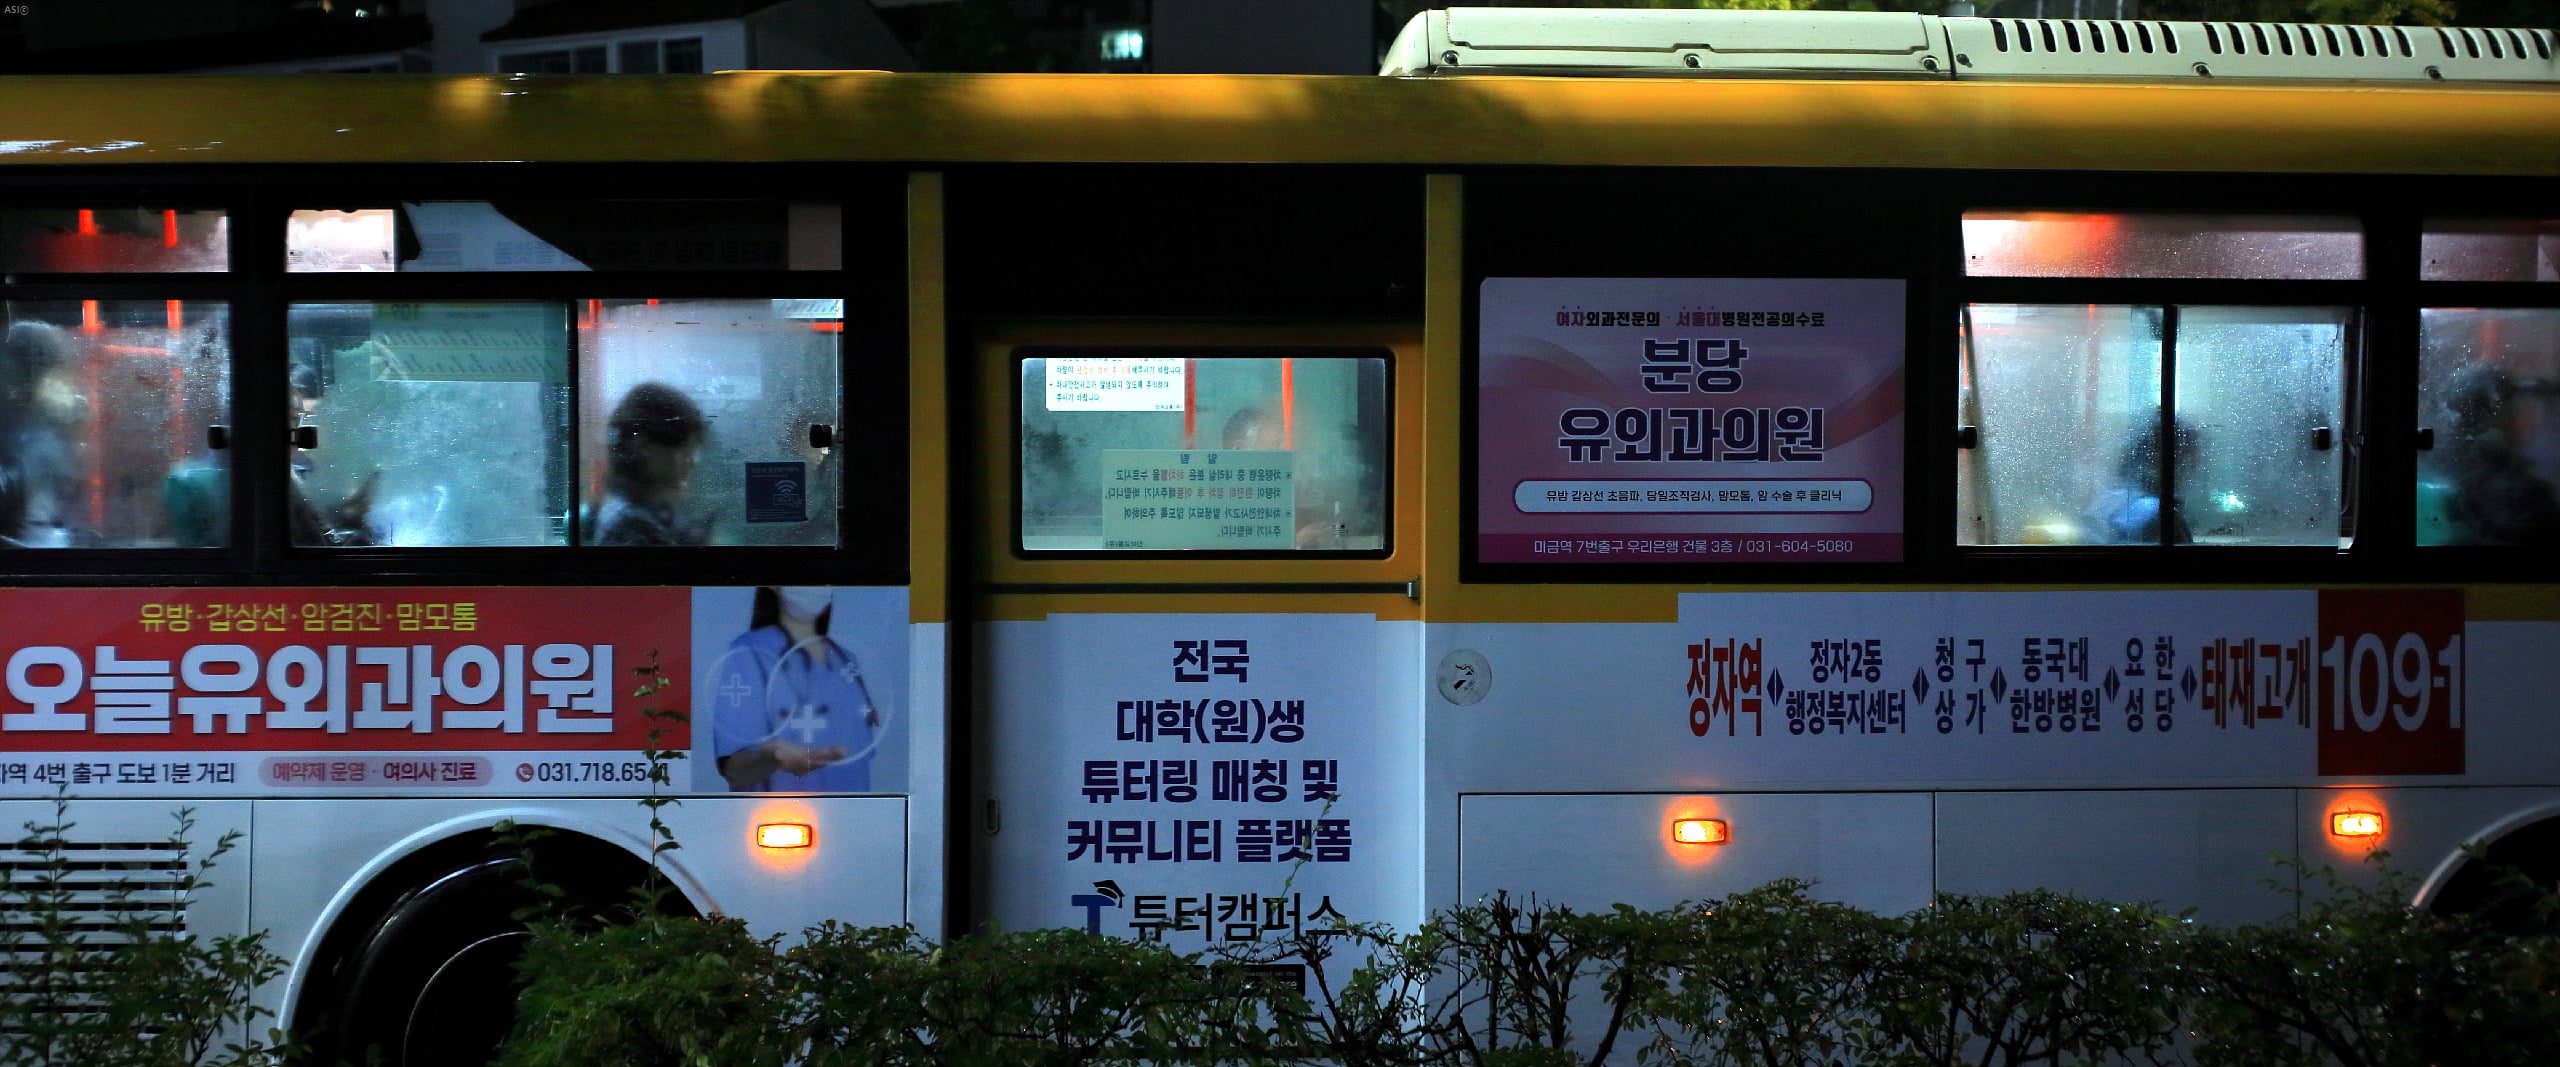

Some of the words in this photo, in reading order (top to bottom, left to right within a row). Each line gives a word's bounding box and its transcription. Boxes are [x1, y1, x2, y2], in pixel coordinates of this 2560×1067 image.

[1556, 311, 1660, 327] 여자외과전문의
[1676, 311, 1825, 327] 서울대병원전공의수료
[1640, 338, 1749, 394] 분당
[1558, 406, 1824, 463] 유외과의원
[1546, 490, 1568, 501] 유방
[1571, 490, 1604, 501] 갑상선
[1646, 490, 1714, 502] 당일조직검사,
[1757, 490, 1768, 501] 암
[1771, 490, 1793, 501] 수술
[1796, 490, 1807, 501] 후
[1810, 490, 1842, 501] 클리닉
[1533, 540, 1572, 553] 미금역
[1576, 540, 1624, 553] 7번출구
[1627, 540, 1679, 553] 우리은행
[1682, 540, 1708, 553] 건물
[1711, 540, 1733, 553] 3층
[1746, 540, 1853, 553] 031-604-5080
[1172, 640, 1250, 683] 전국
[1810, 638, 1883, 683] 정자2동
[2022, 636, 2089, 683] 동국대
[2321, 631, 2462, 733] 109-1
[2, 642, 614, 735] 오늘유외과의원
[1687, 637, 1762, 737] 정자역
[2202, 637, 2311, 730] 태재고개
[1116, 698, 1305, 744] 대학(원)생
[1785, 689, 1906, 736] 행정복지센터
[2010, 687, 2101, 734] 한방병원
[33, 762, 66, 785] 4번
[72, 762, 111, 784] 출구
[116, 762, 156, 784] 도보
[163, 762, 193, 784] 1분
[196, 762, 235, 784] 거리
[272, 762, 326, 782] 예약제
[330, 762, 365, 782] 운영
[383, 762, 436, 782] 여의사
[440, 762, 477, 782] 진료
[1081, 759, 1198, 804] 튜터링
[1212, 759, 1288, 803] 매칭
[1302, 759, 1338, 803] 및
[1067, 819, 1222, 864] 커뮤니티
[1235, 819, 1352, 863] 플랫폼
[1128, 893, 1348, 942] 튜터캠퍼스
